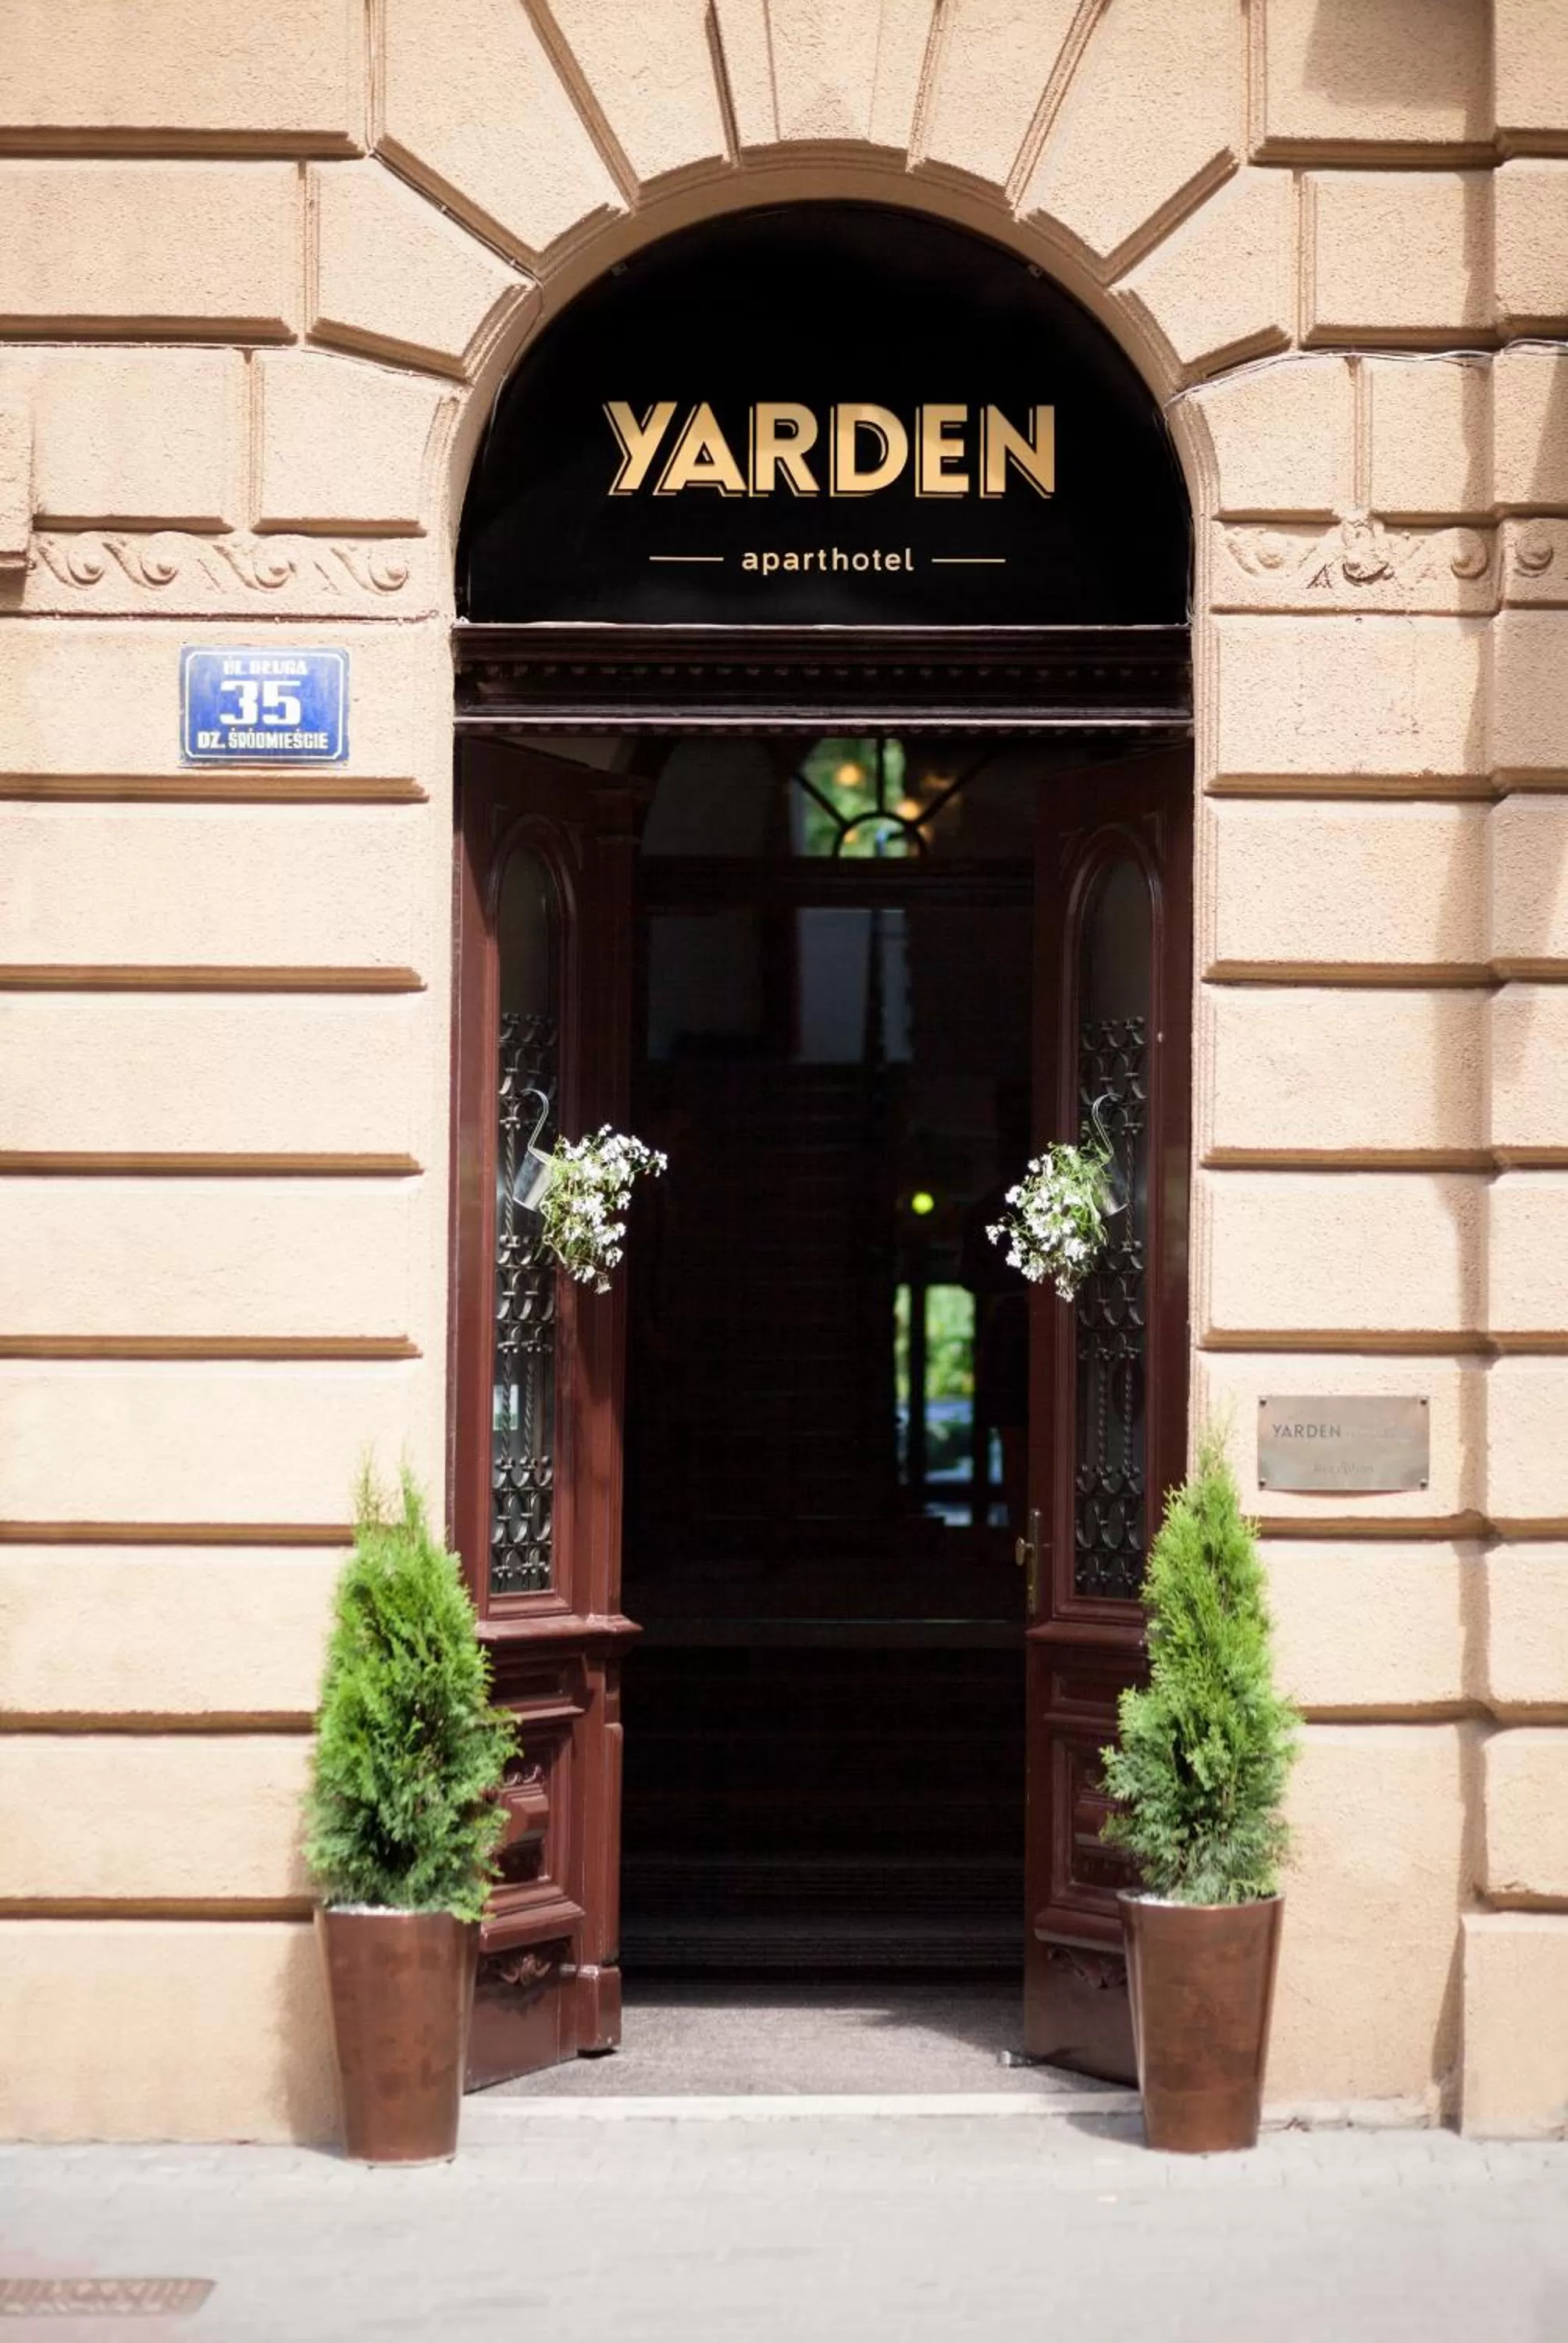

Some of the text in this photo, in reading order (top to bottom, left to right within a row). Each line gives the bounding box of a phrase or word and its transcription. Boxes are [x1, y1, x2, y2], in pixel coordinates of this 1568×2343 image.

[602, 401, 1055, 499] YARDEN
[741, 547, 915, 575] aparthotel
[219, 680, 301, 725] 35
[197, 732, 226, 749] DZ.
[1271, 1424, 1342, 1438] YARDEN
